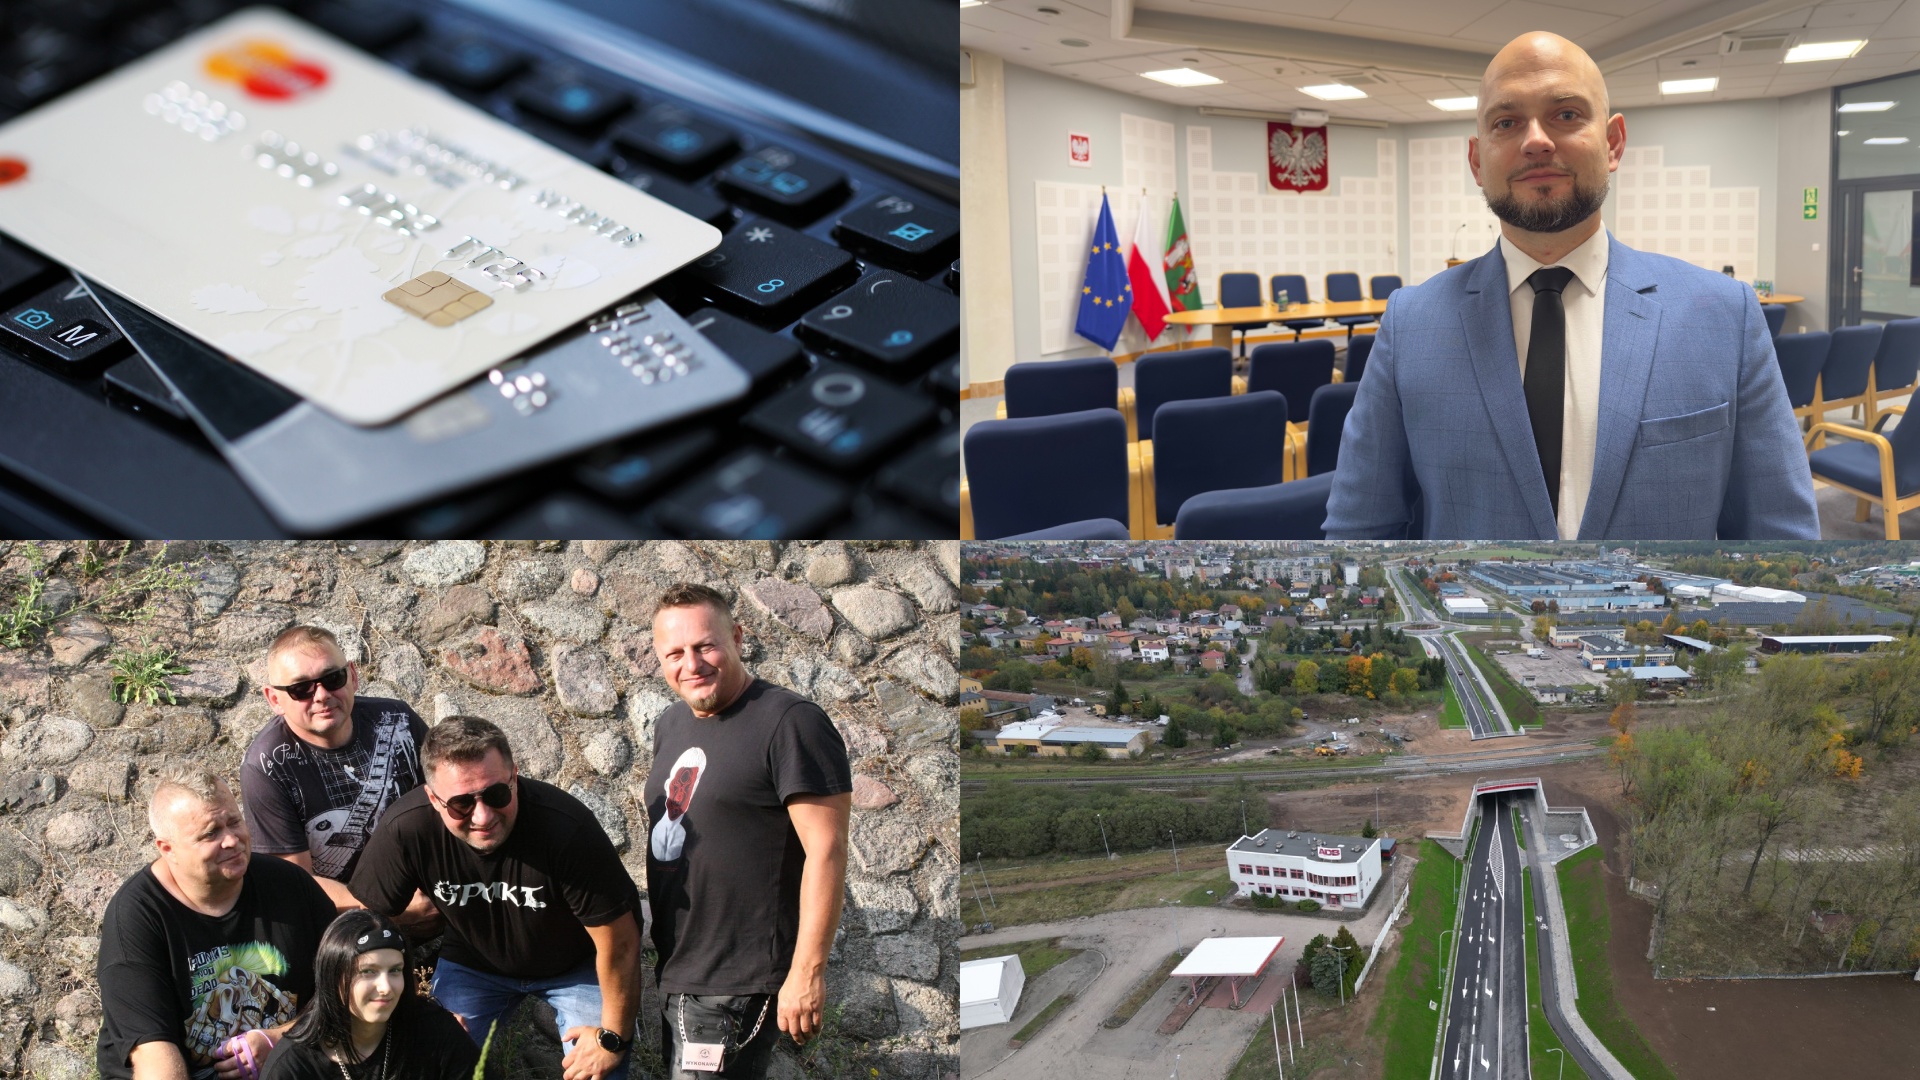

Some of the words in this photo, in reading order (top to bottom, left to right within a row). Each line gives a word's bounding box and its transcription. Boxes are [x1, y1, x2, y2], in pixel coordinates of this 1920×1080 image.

[757, 279, 785, 293] 8
[822, 305, 853, 321] 9
[56, 324, 98, 347] M
[272, 741, 301, 765] Paul
